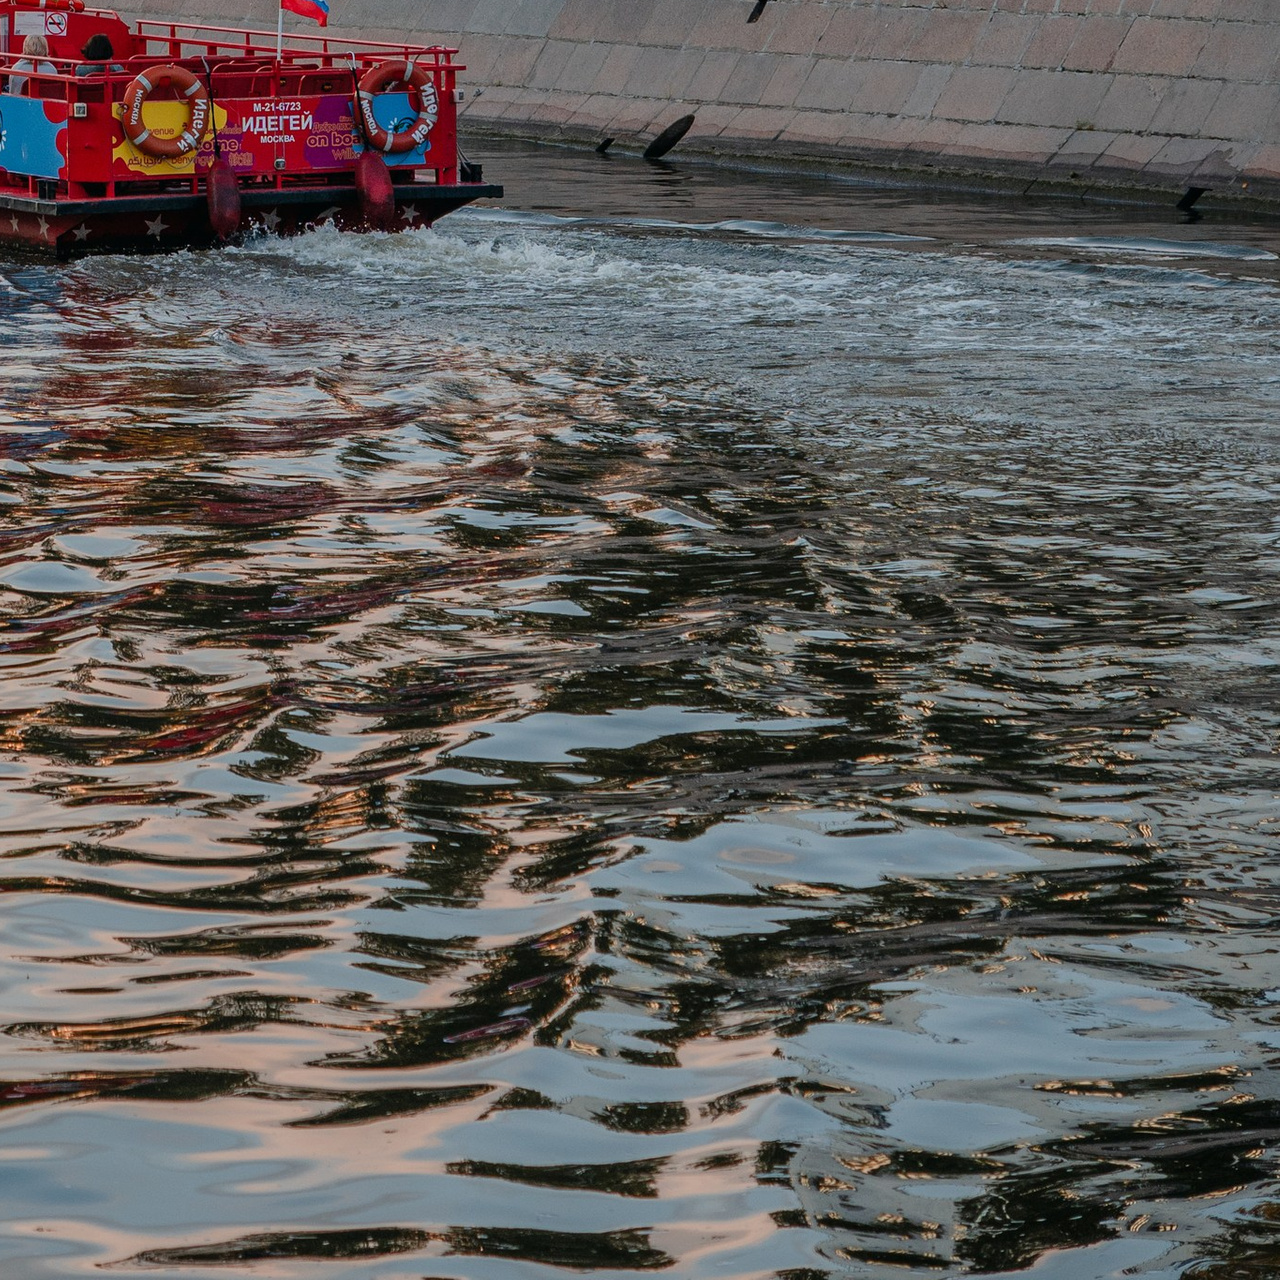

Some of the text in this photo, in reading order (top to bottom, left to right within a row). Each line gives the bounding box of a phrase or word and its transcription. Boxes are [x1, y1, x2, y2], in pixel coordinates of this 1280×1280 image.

[130, 89, 144, 125] МОСКВА
[360, 99, 378, 136] МОСКВА
[412, 82, 438, 147] Идегей
[242, 111, 313, 134] ИДЕГЕЙ
[260, 134, 296, 144] МОСКВА
[306, 134, 328, 148] on
